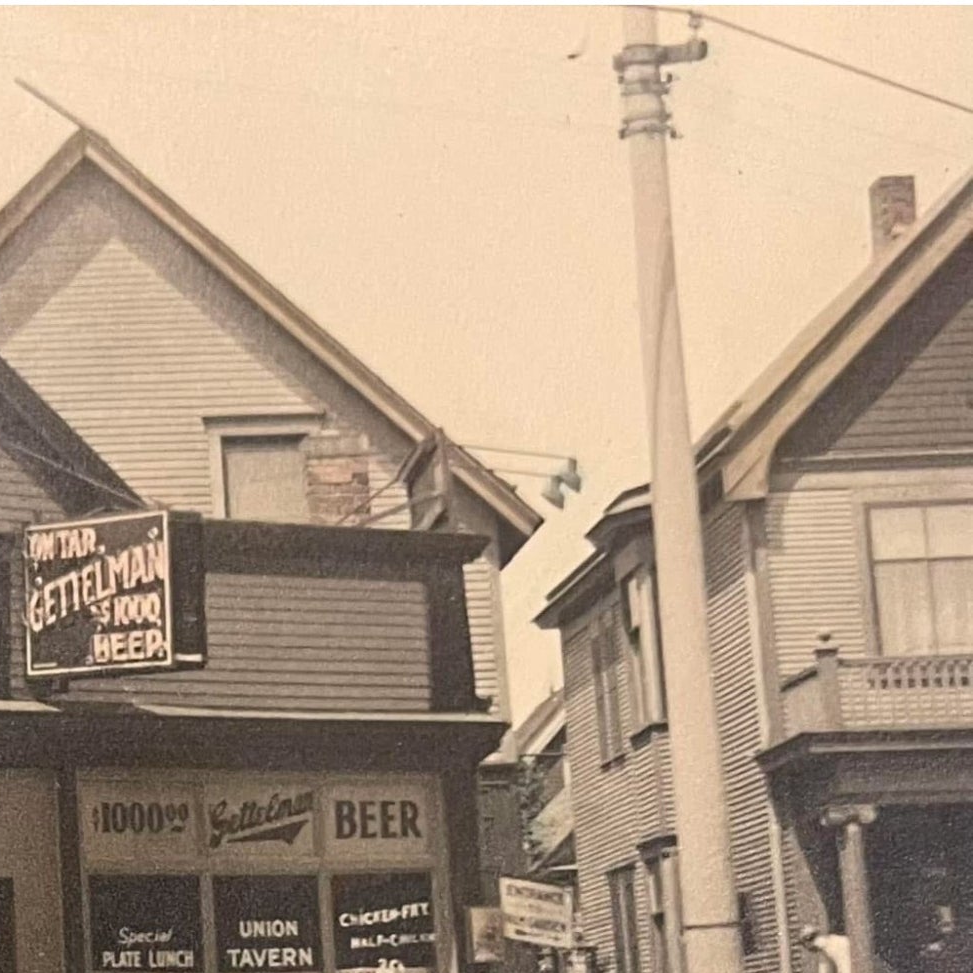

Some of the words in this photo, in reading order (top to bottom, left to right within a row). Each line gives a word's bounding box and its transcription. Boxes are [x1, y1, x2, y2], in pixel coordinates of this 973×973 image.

[29, 541, 165, 632] GETTELMAN
[335, 800, 422, 840] BEER
[118, 926, 173, 947] Special
[239, 919, 298, 938] UNION
[102, 950, 142, 968] PLATE
[148, 949, 194, 968] LUNCH
[227, 947, 313, 968] TAVERN
